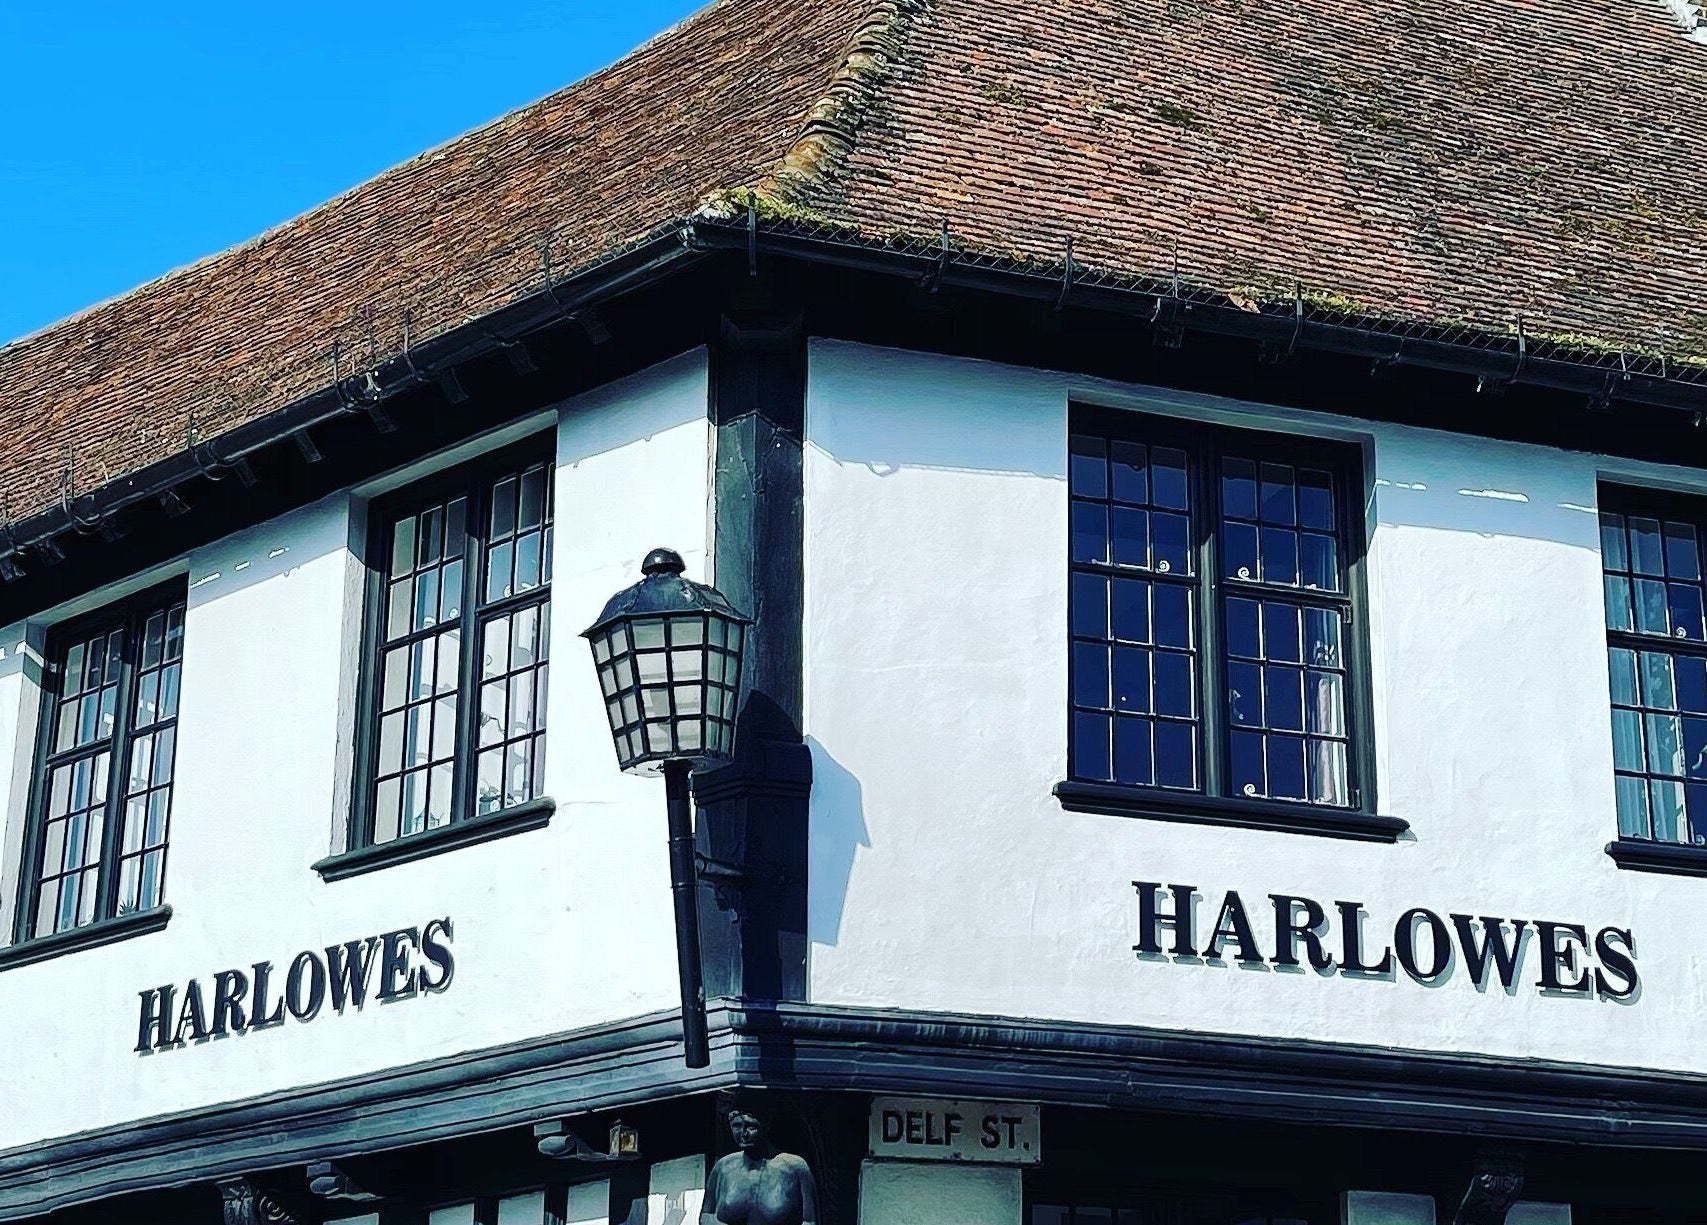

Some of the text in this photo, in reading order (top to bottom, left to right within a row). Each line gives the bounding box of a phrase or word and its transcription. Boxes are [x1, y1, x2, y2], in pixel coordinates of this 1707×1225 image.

[134, 916, 454, 1056] HARLOWES
[1131, 880, 1640, 1002] HARLOWES
[882, 1109, 1030, 1151] DELF ST.
